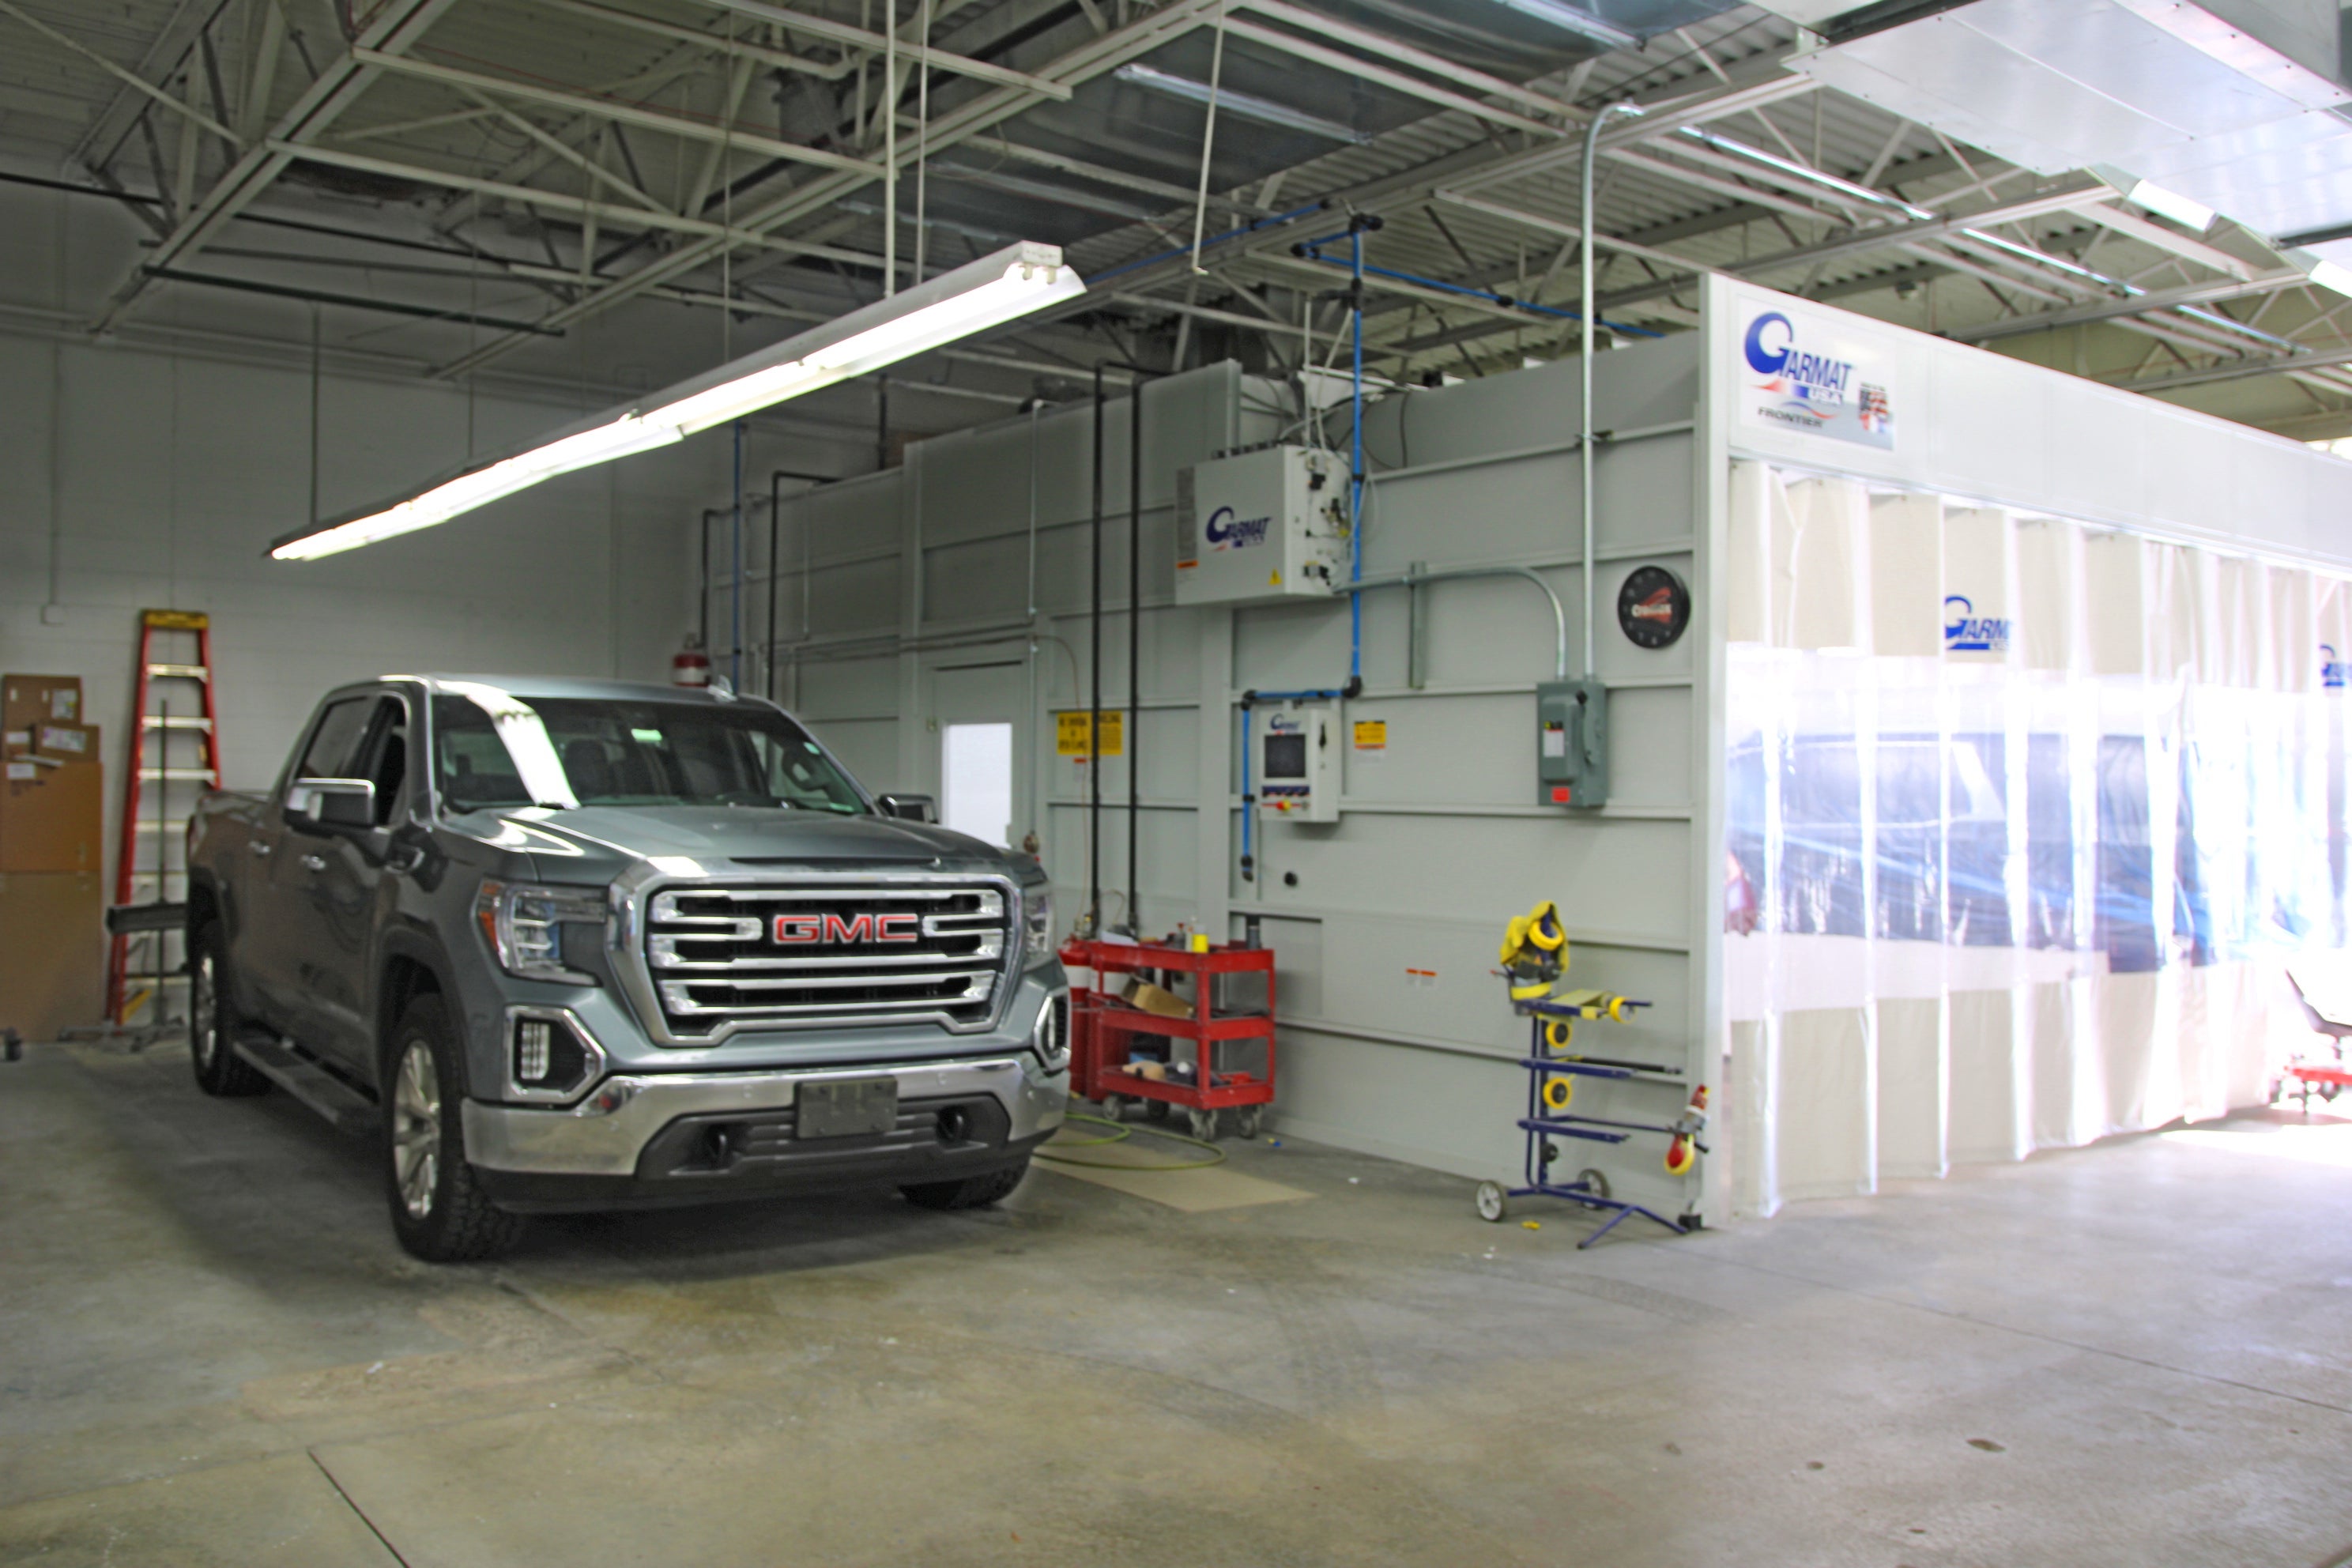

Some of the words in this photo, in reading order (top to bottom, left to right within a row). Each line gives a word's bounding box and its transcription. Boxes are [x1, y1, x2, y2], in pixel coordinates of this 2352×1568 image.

[1744, 311, 1853, 391] GARMAT
[1757, 405, 1823, 428] FRONTIER
[773, 914, 918, 944] GMC
